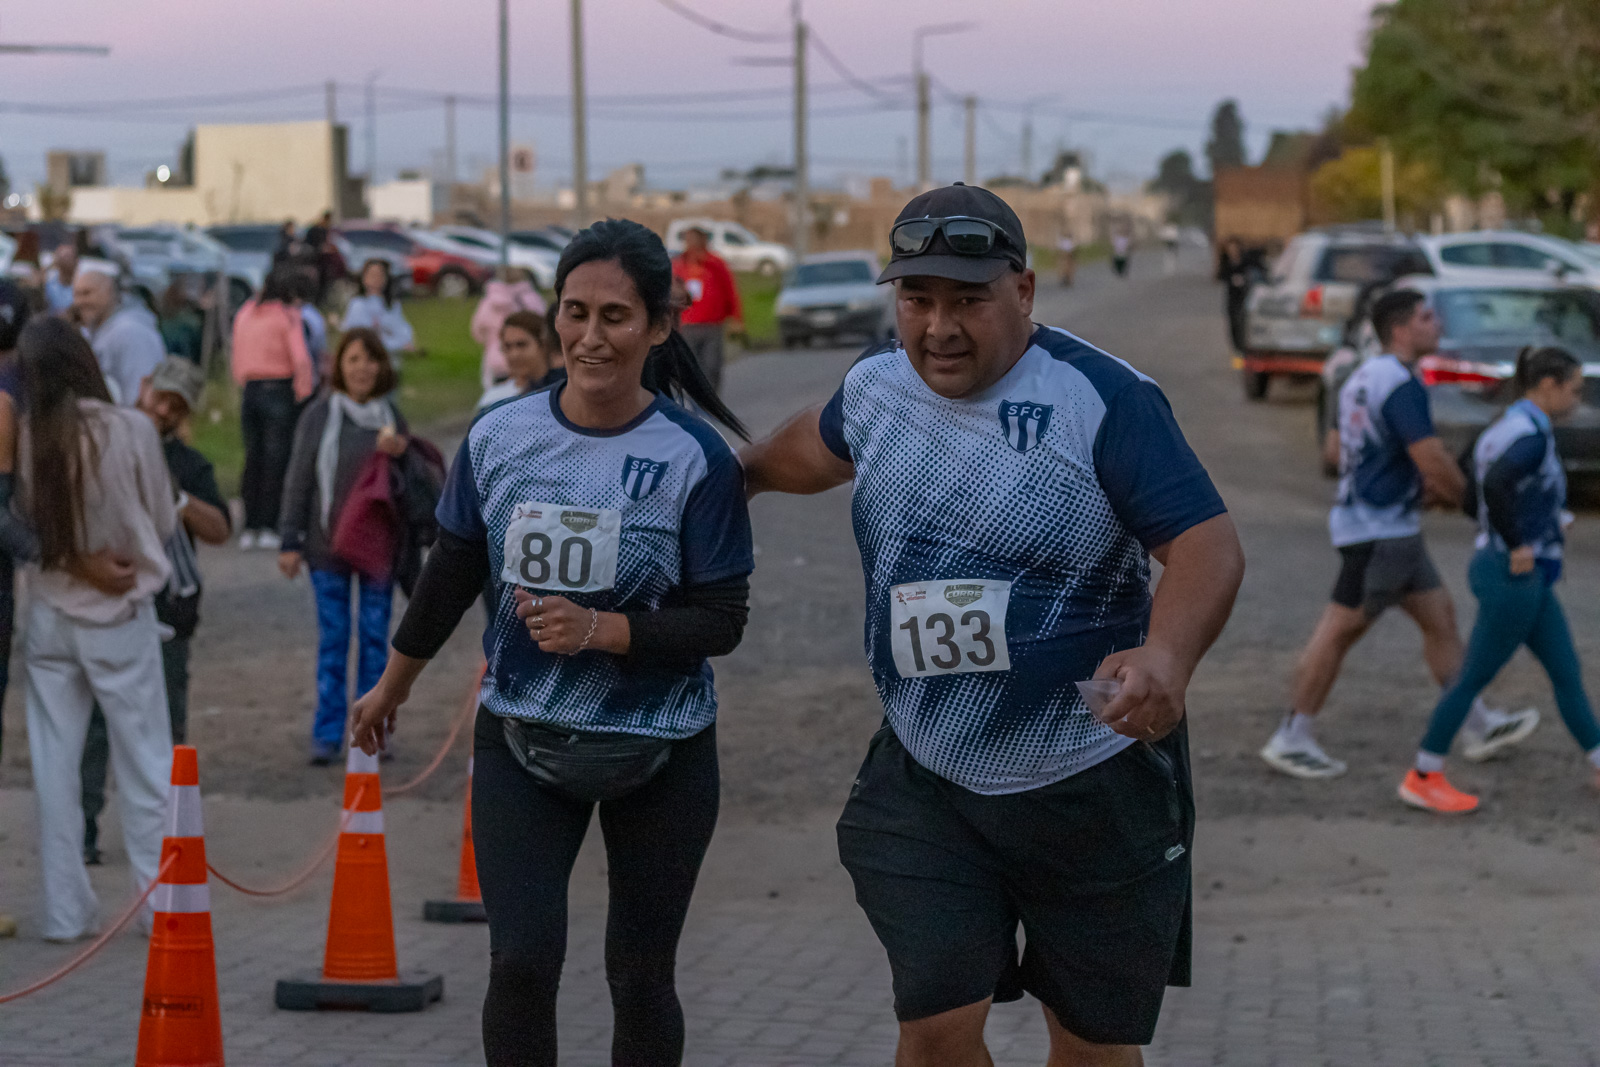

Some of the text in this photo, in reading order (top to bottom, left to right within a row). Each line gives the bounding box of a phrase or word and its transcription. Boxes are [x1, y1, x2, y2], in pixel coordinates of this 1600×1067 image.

[1007, 405, 1042, 419] SFC
[630, 460, 659, 473] SFC
[520, 532, 593, 588] 80
[946, 590, 982, 599] CORRE
[899, 610, 995, 671] 133
